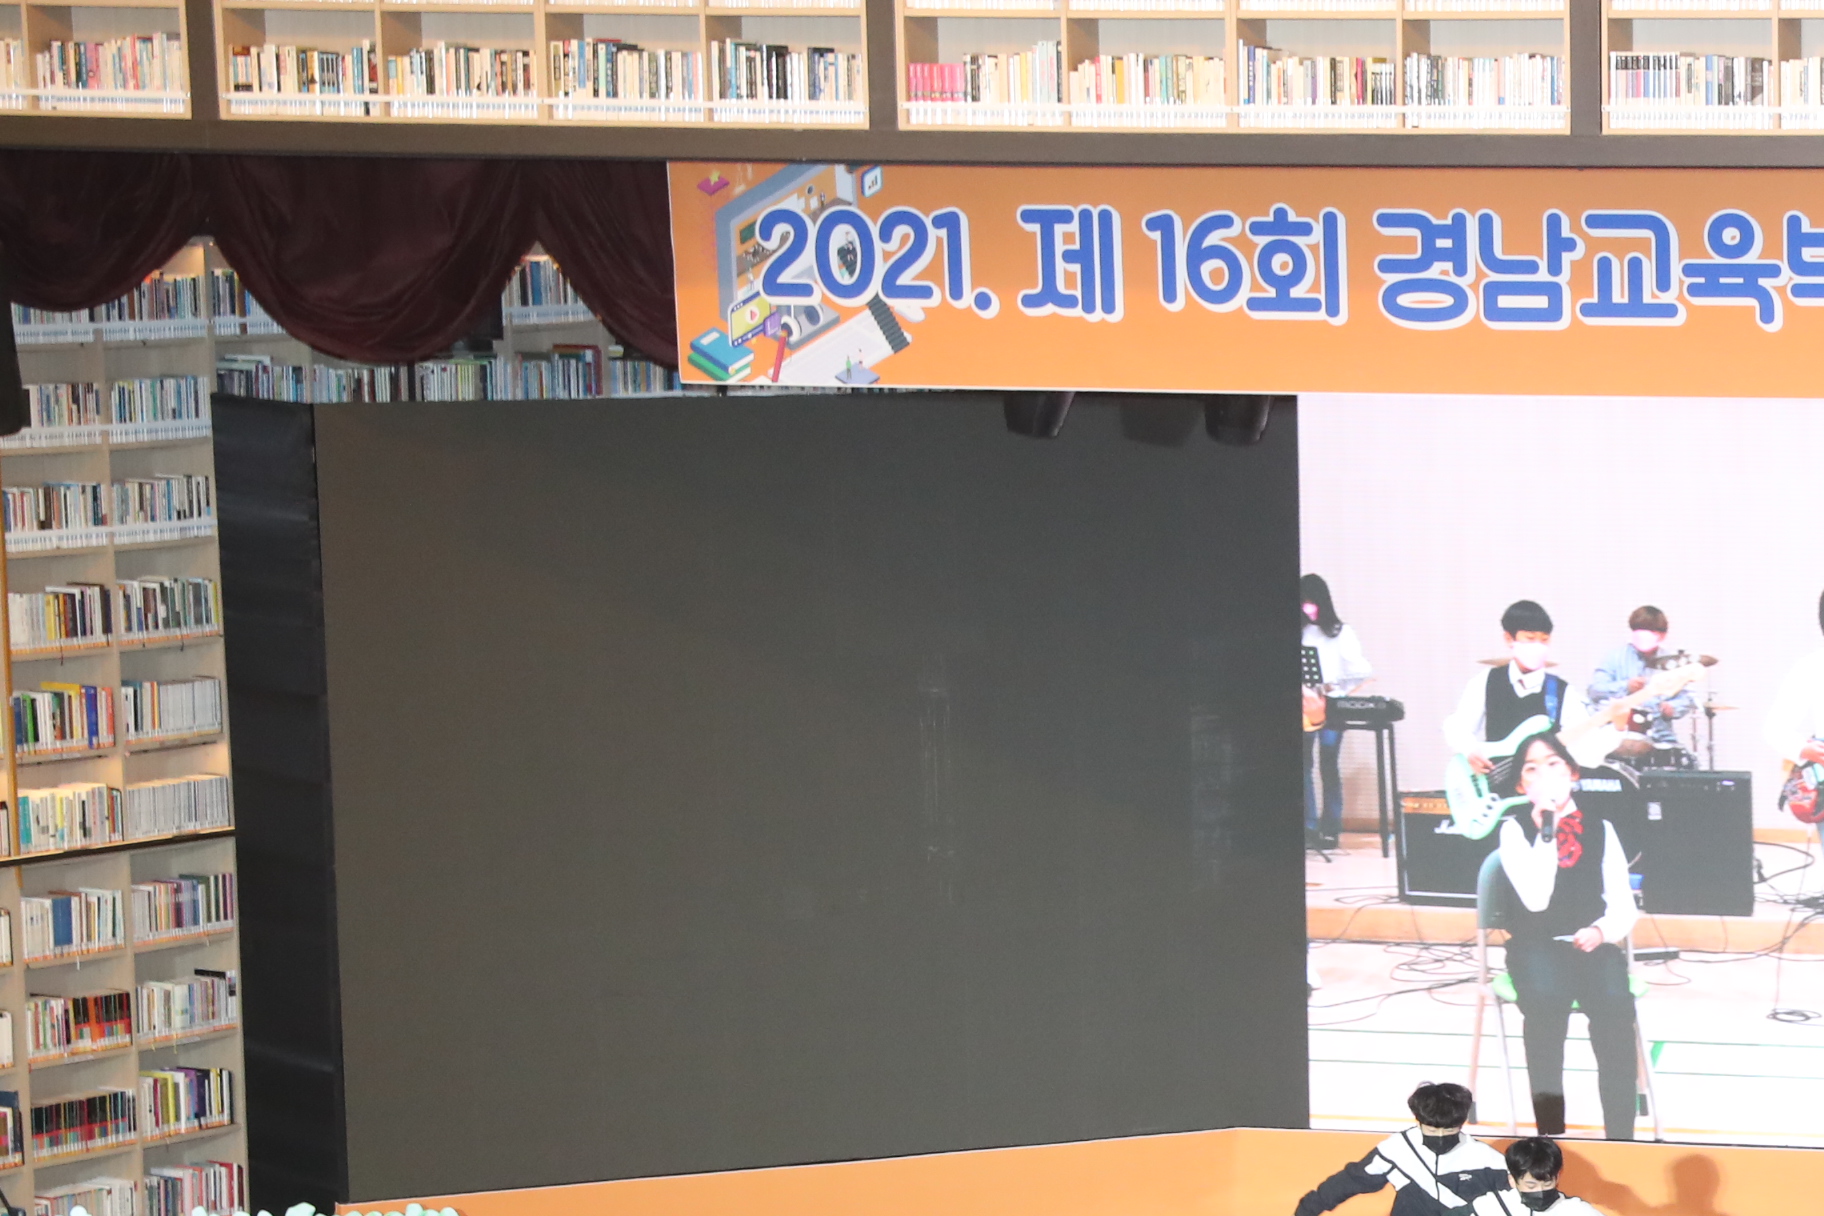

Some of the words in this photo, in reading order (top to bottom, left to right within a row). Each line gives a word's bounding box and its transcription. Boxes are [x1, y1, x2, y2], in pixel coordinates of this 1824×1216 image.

[756, 207, 996, 316] 2021.
[1017, 205, 1120, 319] 제
[1142, 204, 1346, 323] 16회
